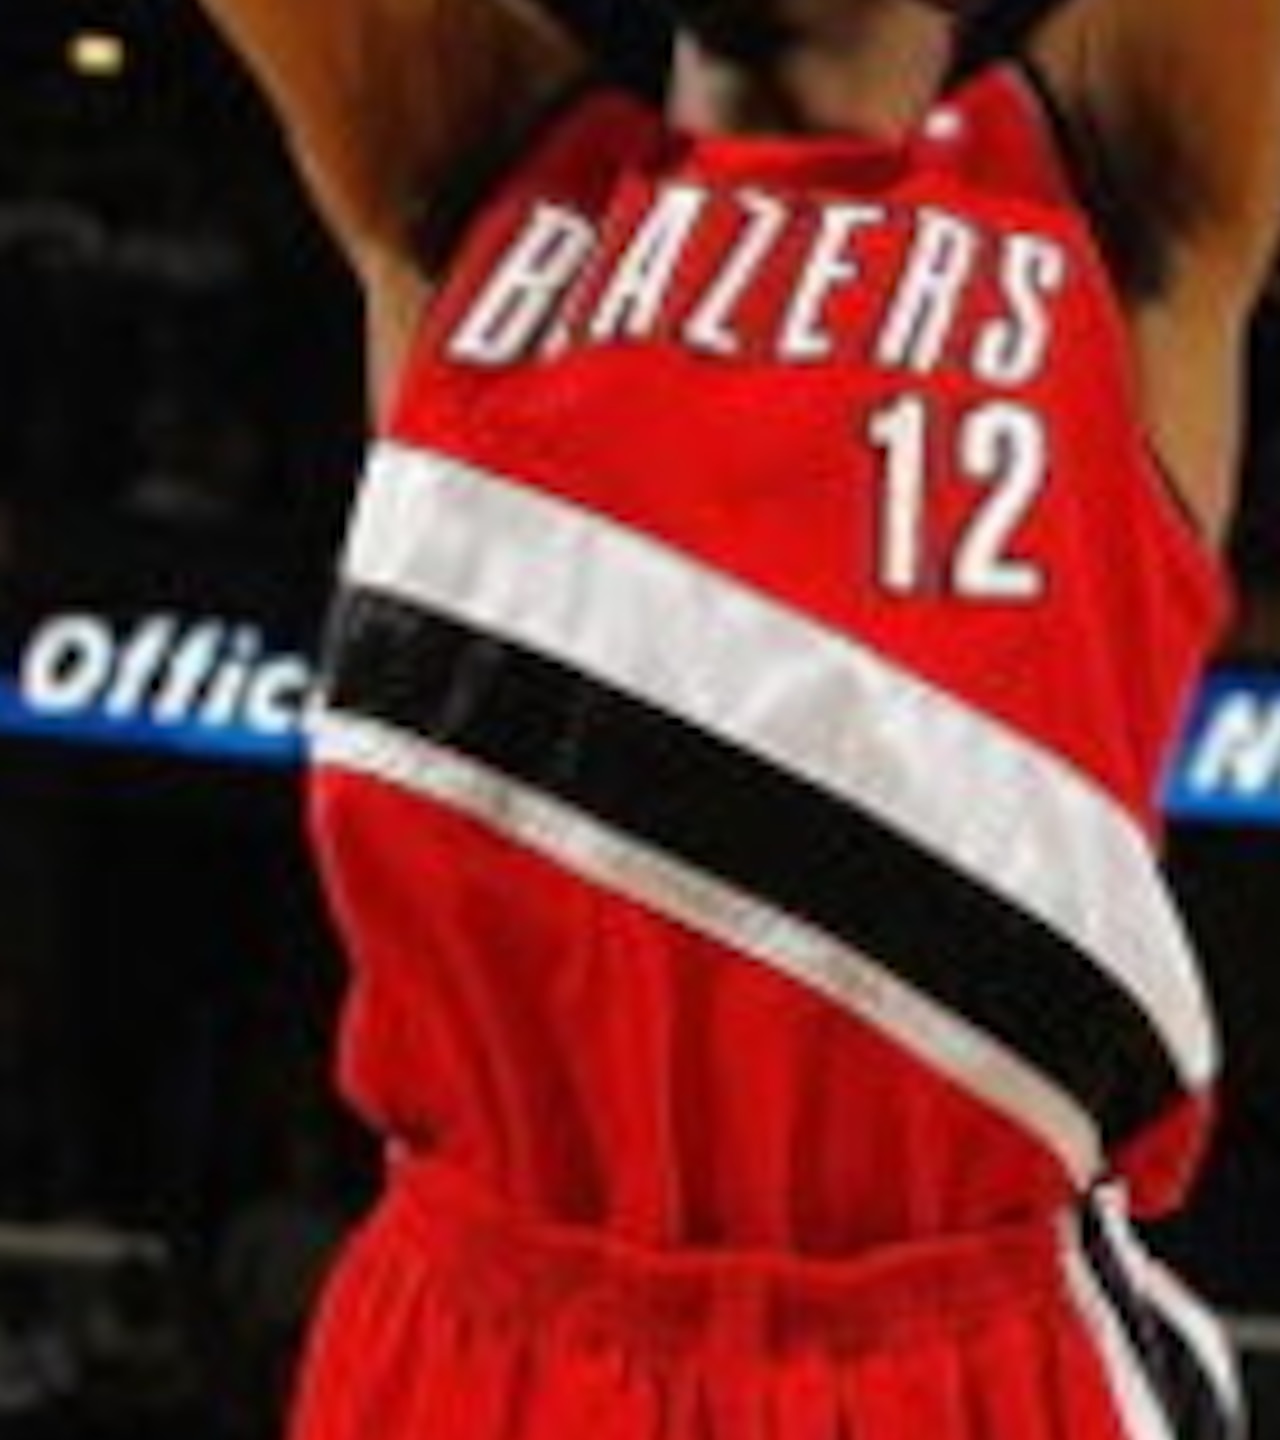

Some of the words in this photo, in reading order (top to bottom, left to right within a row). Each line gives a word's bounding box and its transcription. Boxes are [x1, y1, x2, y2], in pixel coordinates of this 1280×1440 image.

[444, 179, 1070, 388] BAZERS
[866, 391, 1048, 602] 12
[21, 611, 312, 734] Offic
